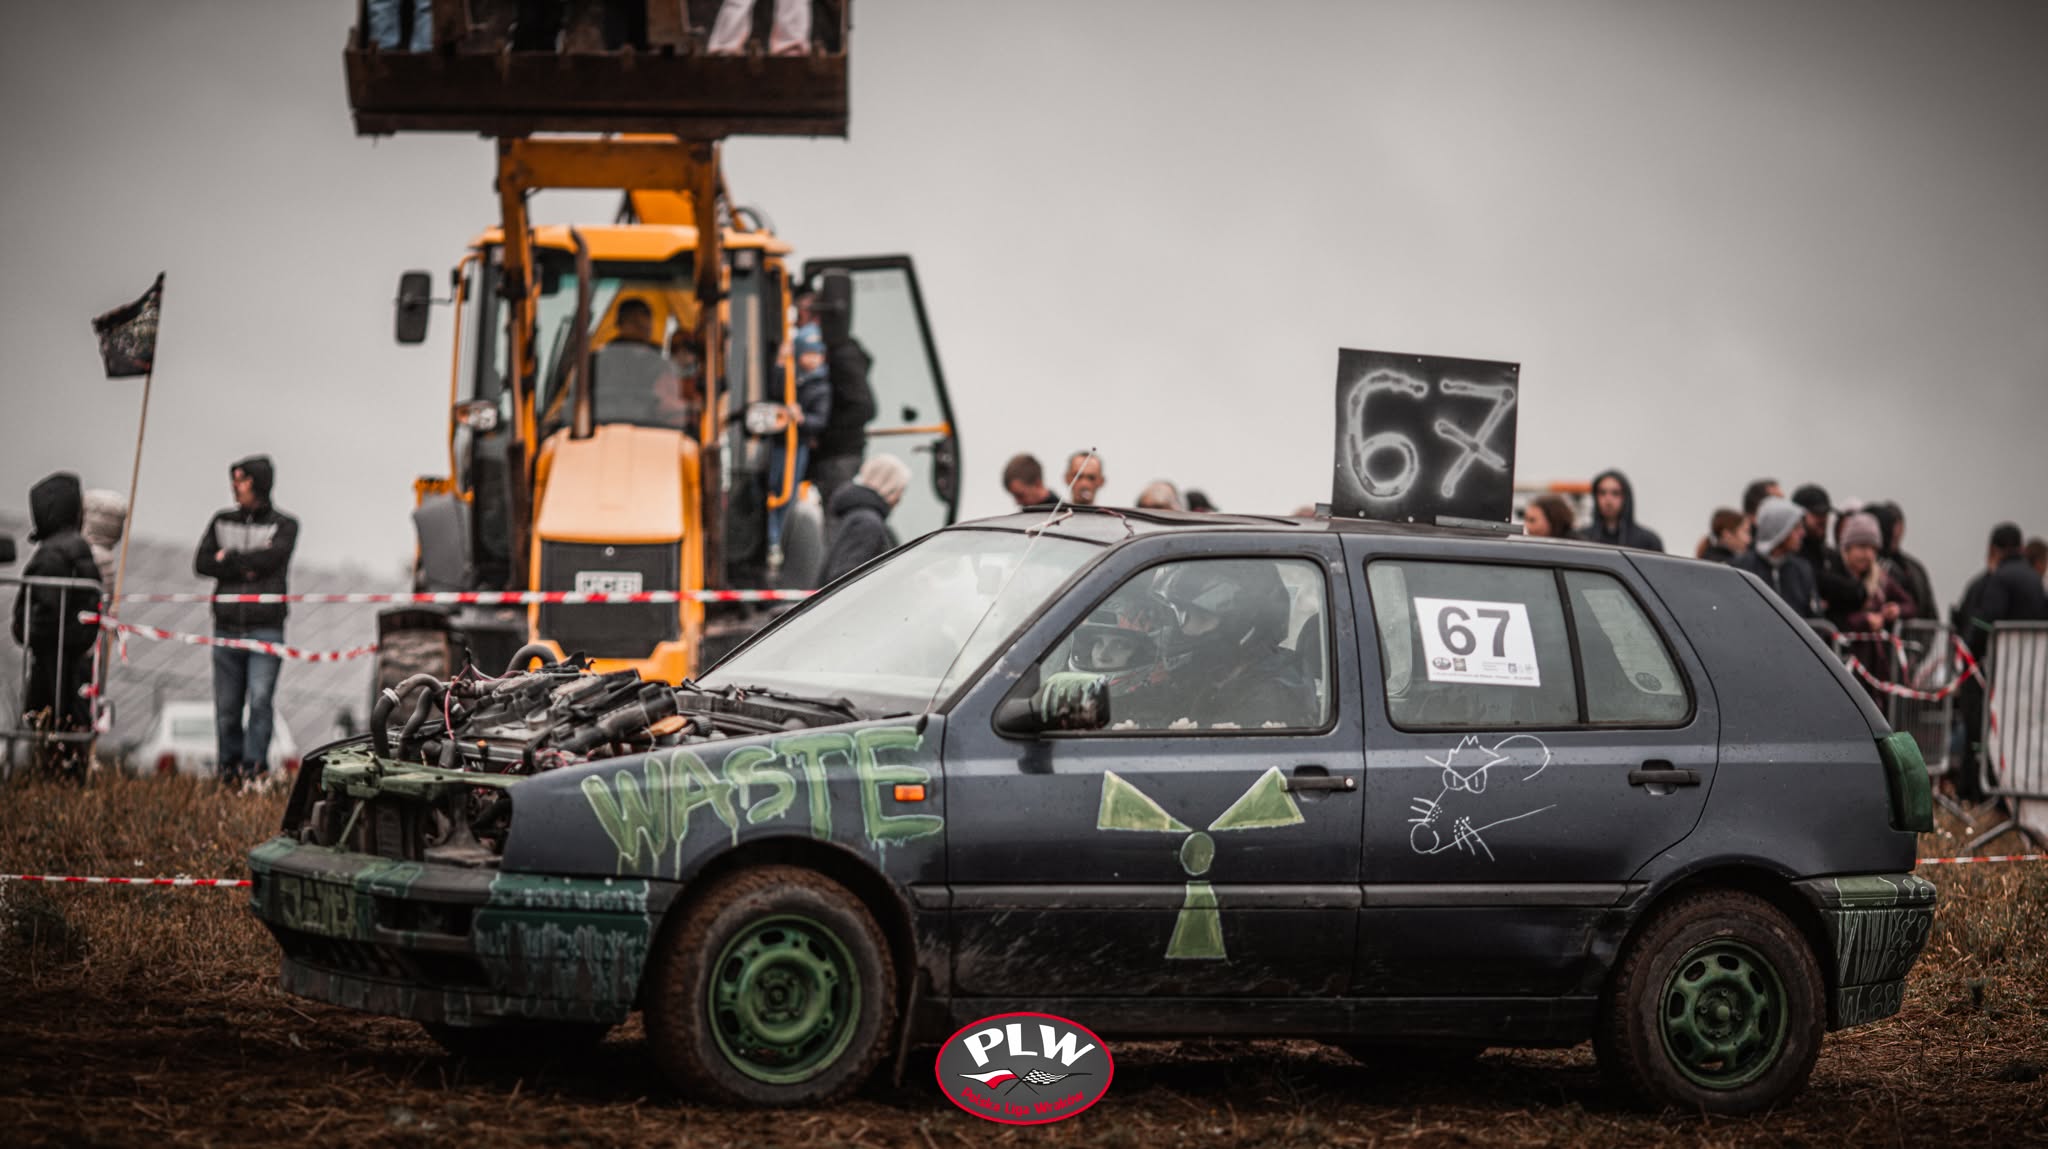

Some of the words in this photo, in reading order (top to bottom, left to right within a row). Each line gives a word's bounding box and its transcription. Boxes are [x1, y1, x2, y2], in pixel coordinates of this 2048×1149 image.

[1347, 369, 1516, 500] 67
[1437, 606, 1510, 657] 67
[581, 727, 944, 868] WASTE
